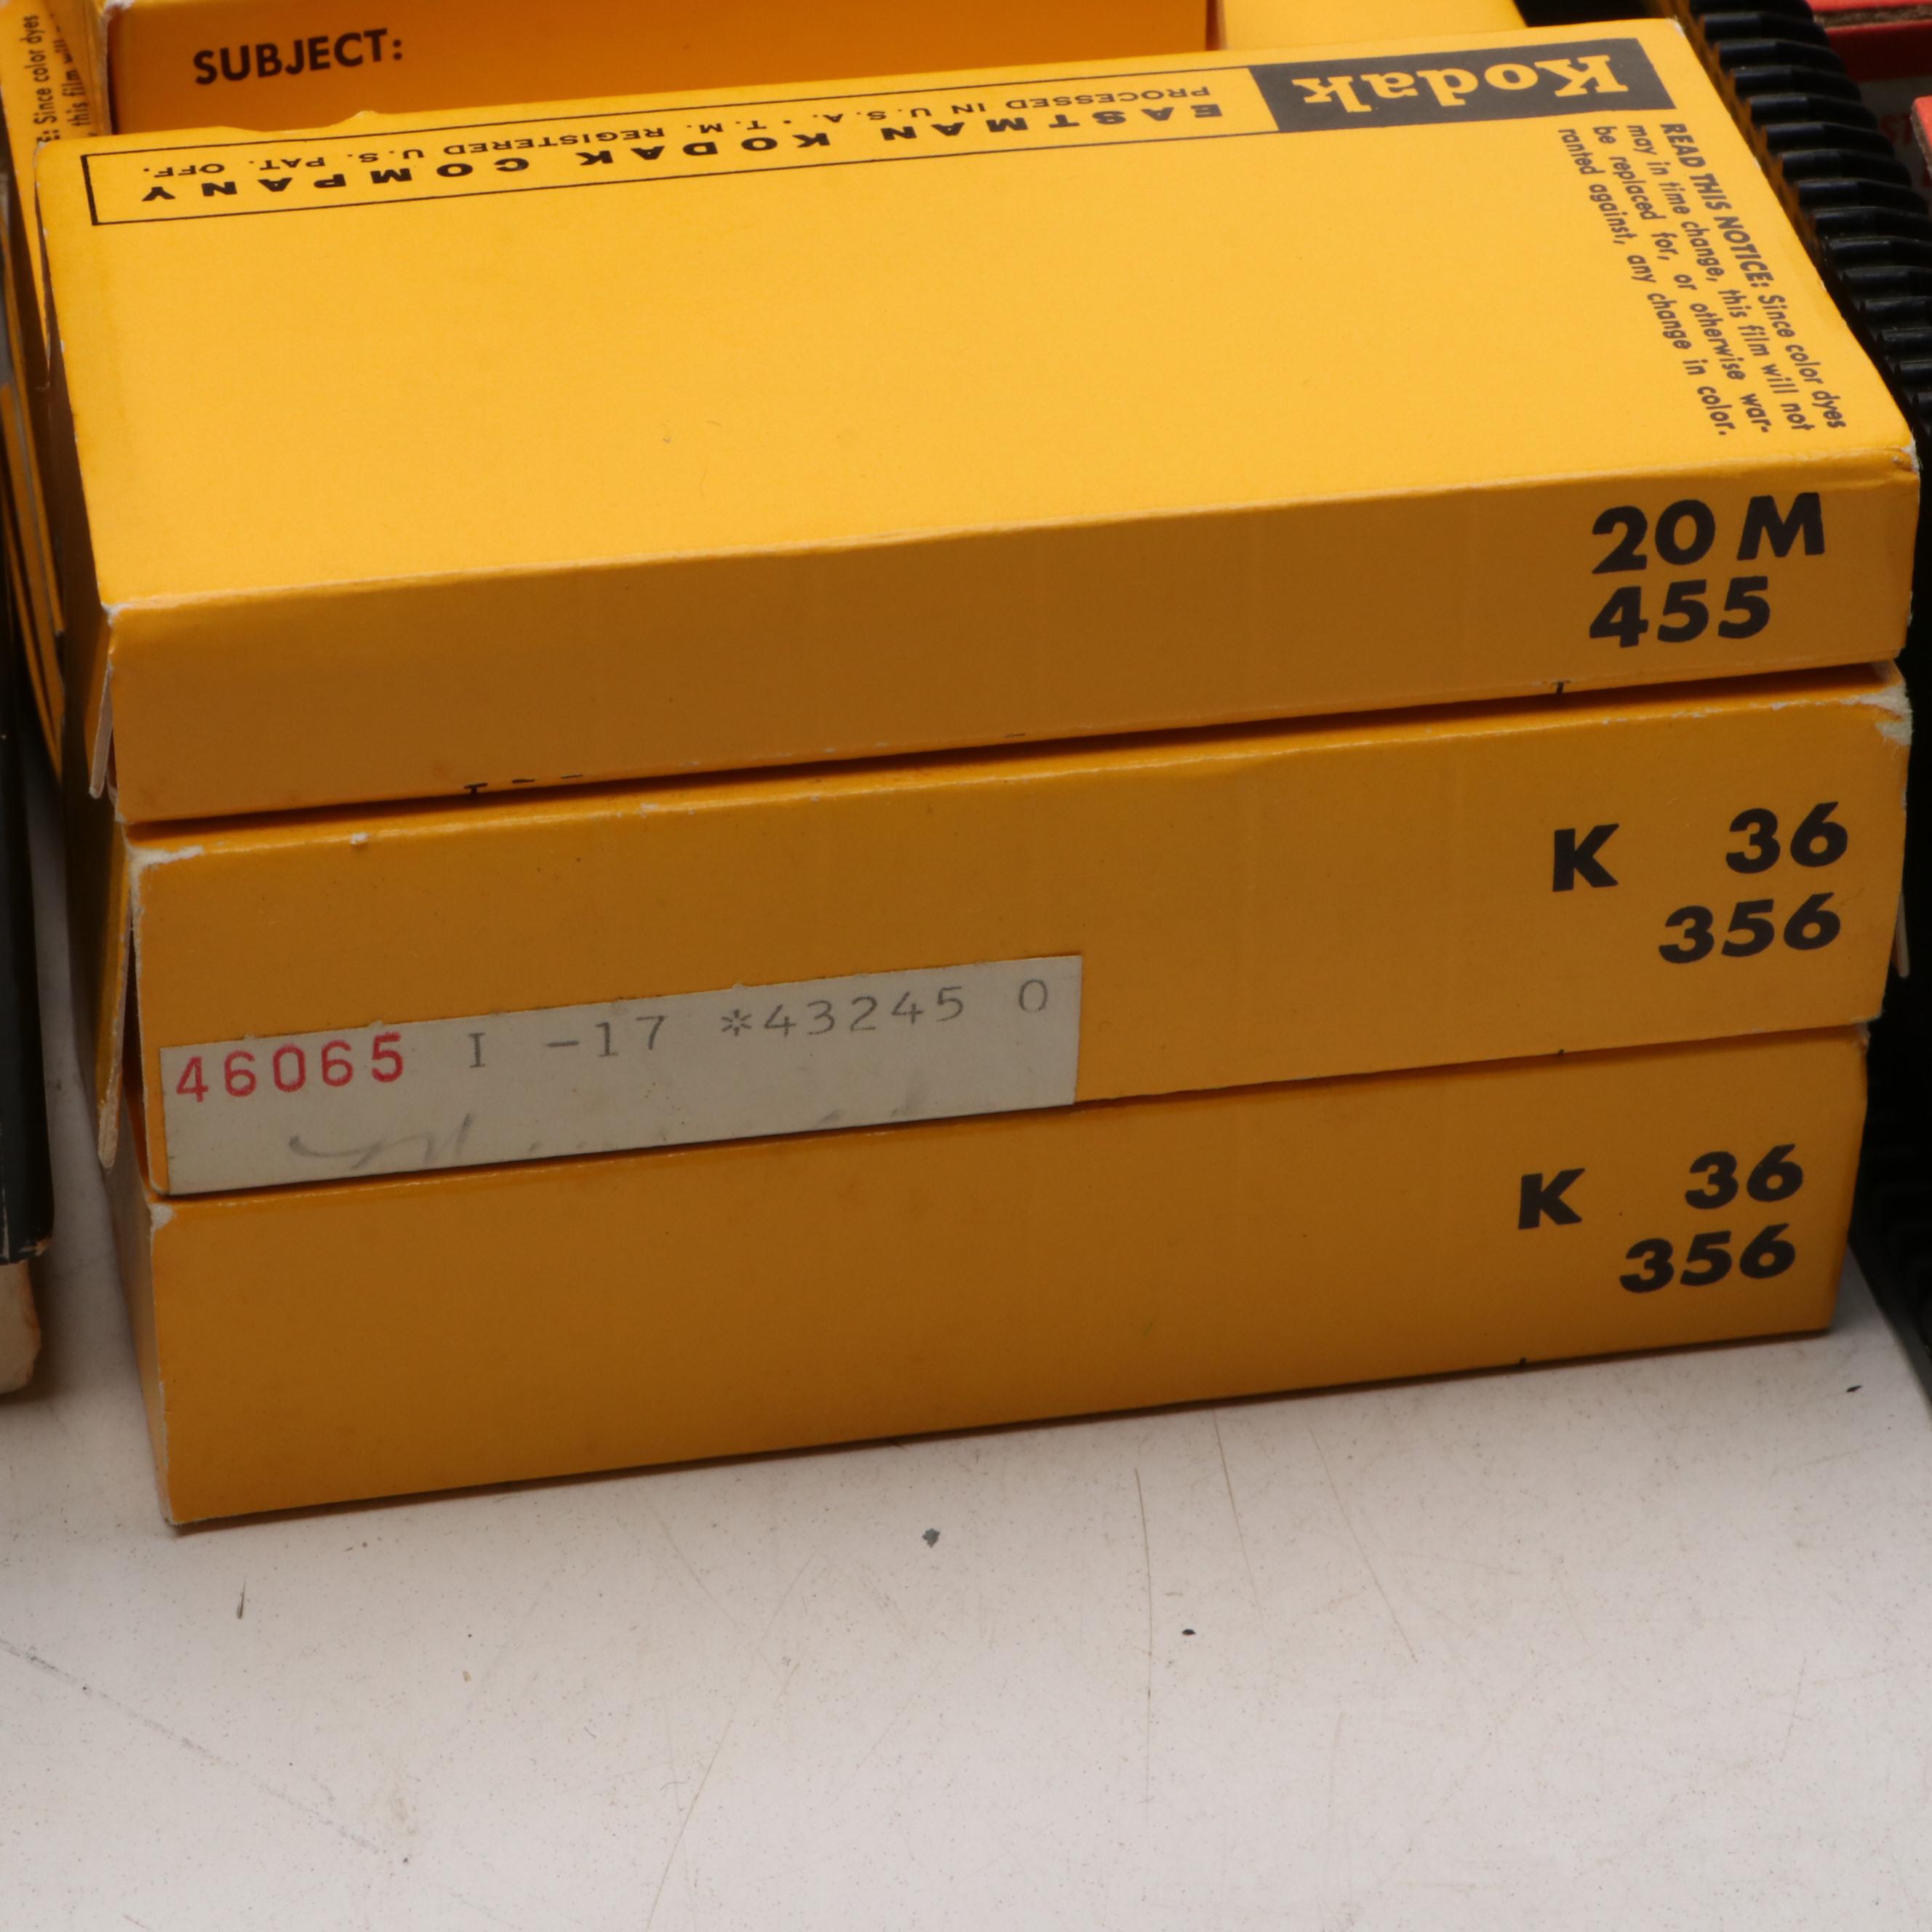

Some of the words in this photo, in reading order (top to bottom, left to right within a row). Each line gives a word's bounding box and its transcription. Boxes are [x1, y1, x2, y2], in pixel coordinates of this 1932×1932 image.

[20, 15, 45, 44] dyes
[193, 28, 402, 85] SUBJECT:
[25, 50, 49, 82] color
[1292, 55, 1628, 112] Kodak
[33, 88, 57, 124] Since
[68, 102, 91, 126] this
[881, 104, 1221, 141] EASTMAN
[951, 103, 985, 113] IN
[1006, 87, 1209, 108] PROCESSED
[250, 157, 325, 170] PAT.
[444, 128, 664, 154] REGISTERED
[576, 132, 830, 166] KODAK
[144, 164, 224, 177] OFF.
[144, 157, 530, 201] COMPANY
[1559, 128, 1605, 175] ranted
[1589, 184, 1637, 244] against,
[1627, 255, 1656, 282] any
[1648, 293, 1691, 349] change
[1683, 359, 1708, 375] in
[1697, 386, 1735, 435] color.
[1593, 127, 1616, 145] be
[1610, 157, 1659, 220] replaced
[1652, 233, 1678, 260] for,
[1674, 274, 1697, 290] or
[1689, 303, 1745, 380] otherwise
[1740, 394, 1771, 432] war-
[1628, 126, 1656, 154] may
[1647, 162, 1670, 175] in
[1659, 183, 1690, 214] time
[1681, 222, 1724, 281] change,
[1718, 290, 1747, 317] this
[1738, 325, 1769, 356] film
[1762, 364, 1798, 394] will
[1781, 404, 1815, 430] not
[1661, 124, 1705, 167] READ
[1690, 174, 1731, 209] THIS
[1714, 217, 1773, 287] NOTICE:
[1758, 295, 1795, 337] Since
[1785, 345, 1823, 383] color
[1812, 391, 1846, 428] dyes
[1592, 500, 1715, 573] 20
[1737, 492, 1824, 560] M
[1589, 576, 1770, 647] 455
[1553, 824, 1618, 891] K
[1726, 802, 1848, 874] 36
[1659, 893, 1840, 964] 356
[177, 1029, 403, 1102] 46065
[1519, 1168, 1584, 1229] K
[1685, 1144, 1803, 1209] 36
[1620, 1224, 1795, 1293] 356
